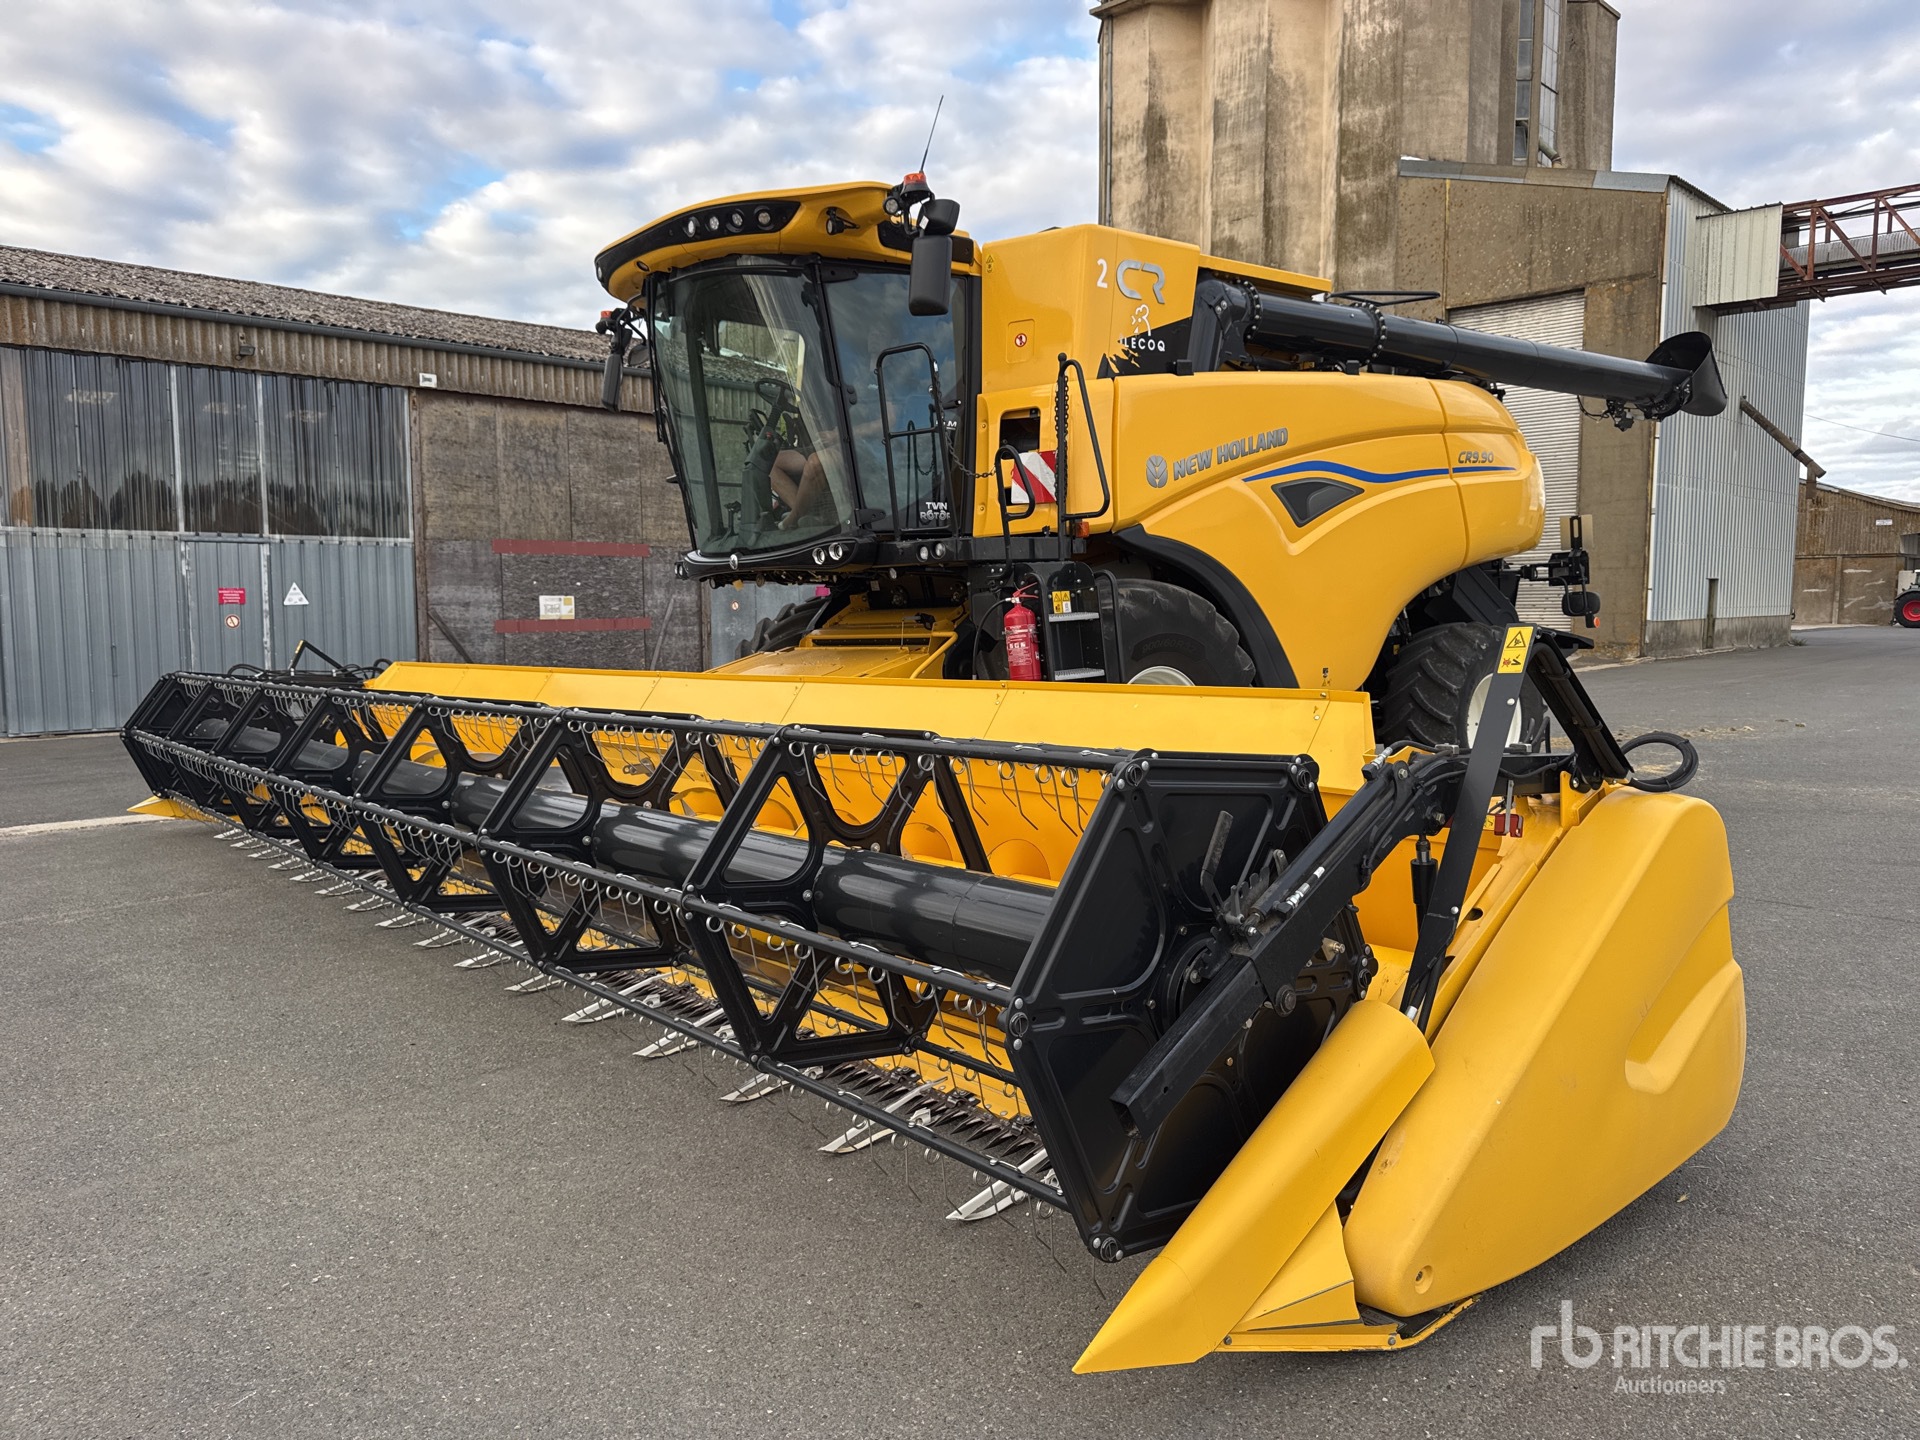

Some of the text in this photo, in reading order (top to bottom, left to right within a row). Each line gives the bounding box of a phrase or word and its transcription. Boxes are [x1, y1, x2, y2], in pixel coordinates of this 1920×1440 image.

[1096, 258, 1108, 289] 2
[1115, 259, 1165, 305] CR
[1173, 427, 1289, 481] NEW HOLLAND
[1457, 450, 1495, 464] CR9.90
[925, 501, 948, 511] TWIN
